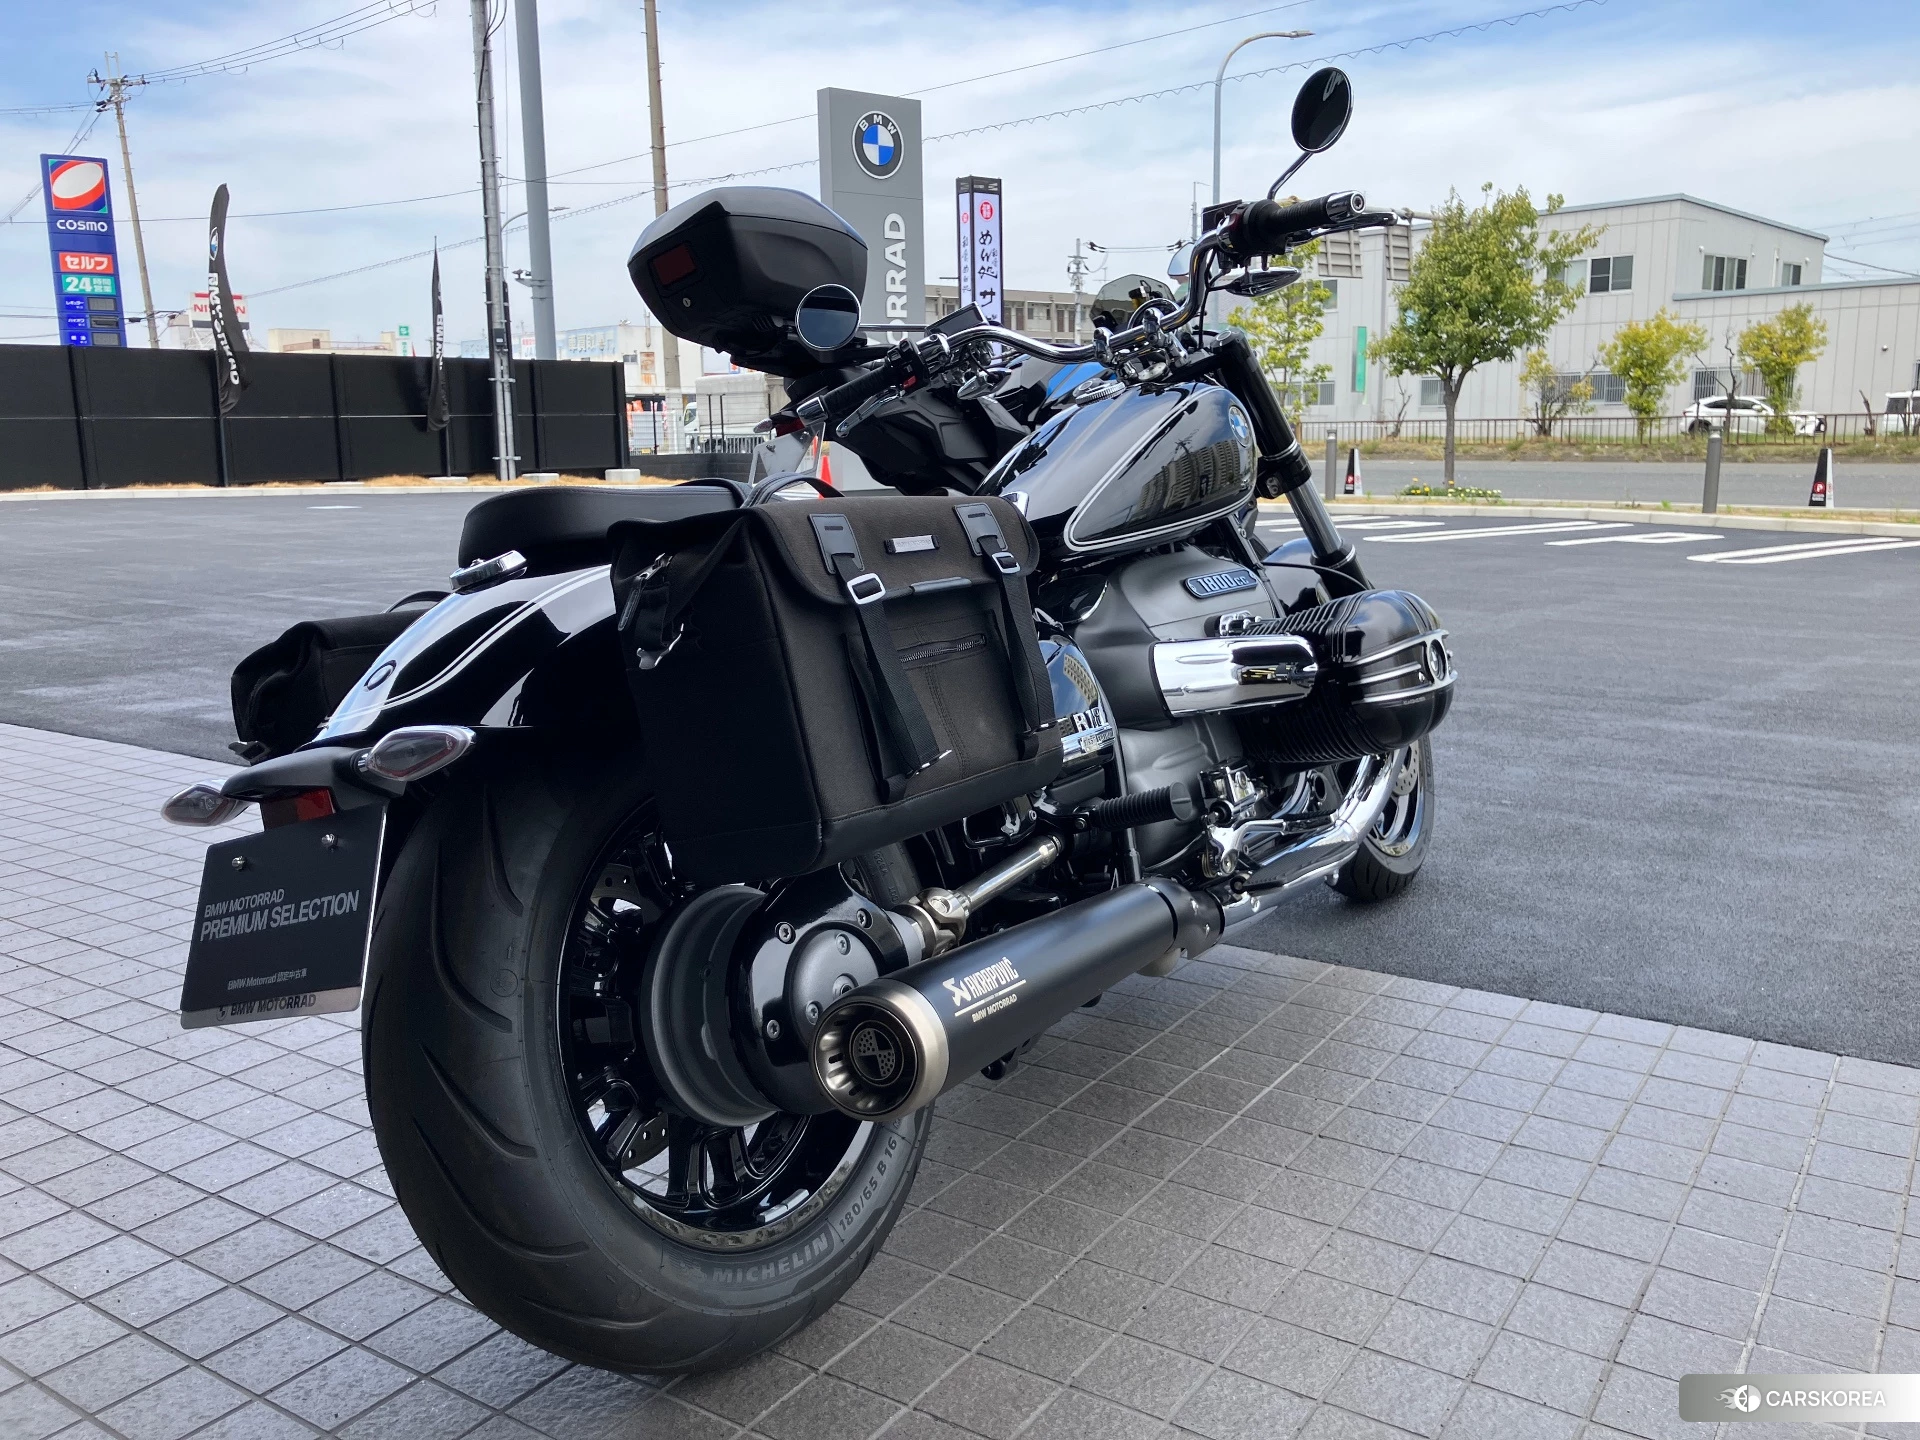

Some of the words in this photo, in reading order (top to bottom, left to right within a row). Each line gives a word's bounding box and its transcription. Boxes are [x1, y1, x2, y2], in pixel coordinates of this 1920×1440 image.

[859, 114, 897, 135] BMW
[56, 219, 108, 232] COSMO
[65, 255, 108, 270] セルフ
[65, 276, 92, 292] 24
[194, 304, 246, 314] NIN
[204, 901, 229, 918] BMW
[229, 888, 285, 911] MOTORRAD
[200, 909, 269, 941] PREMIUM
[269, 890, 360, 928] SELECTION
[227, 978, 247, 990] BMW
[231, 1001, 256, 1016] BMW
[257, 994, 316, 1013] MOTORRAD
[987, 993, 1018, 1015] MOTORRAD
[839, 1176, 878, 1231] 180/65
[876, 1161, 887, 1177] B
[885, 1136, 897, 1158] 16
[712, 1232, 829, 1284] MICHELIN
